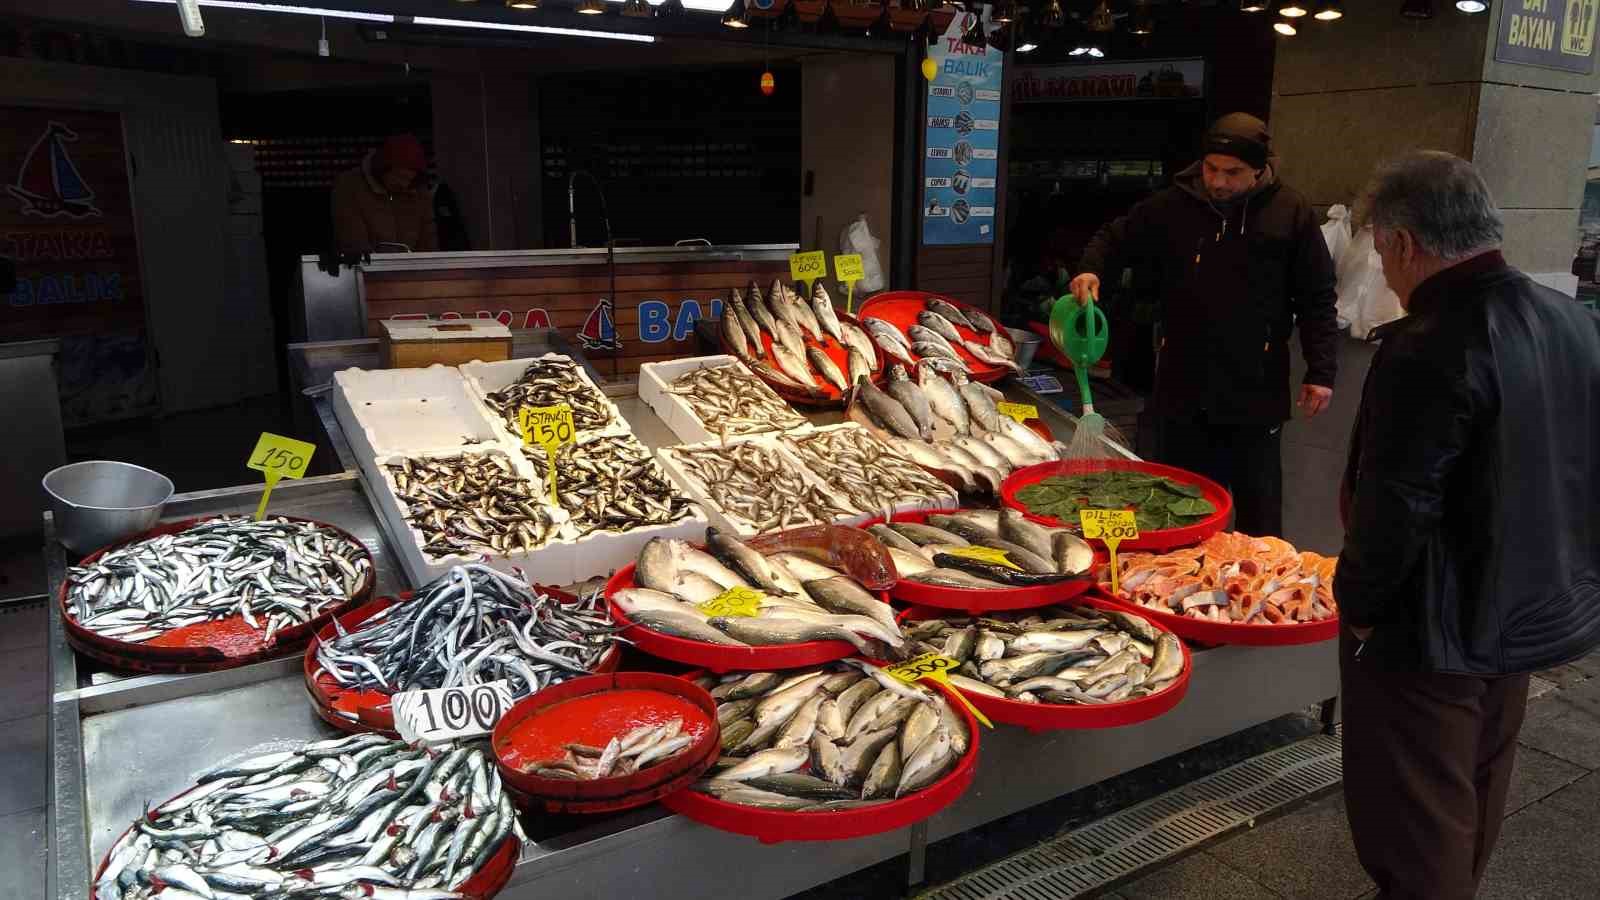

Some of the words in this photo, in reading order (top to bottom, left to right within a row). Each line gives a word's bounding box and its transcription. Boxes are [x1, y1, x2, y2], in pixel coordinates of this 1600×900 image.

[1508, 14, 1556, 51] BAYAN
[1570, 37, 1585, 49] WC
[944, 58, 991, 78] BALIK
[7, 231, 114, 260] TAKA
[798, 261, 820, 272] 600
[9, 271, 123, 305] BALIK
[526, 422, 571, 445] 150
[253, 447, 304, 470] 150
[897, 658, 949, 680] 300
[417, 686, 501, 733] 100
